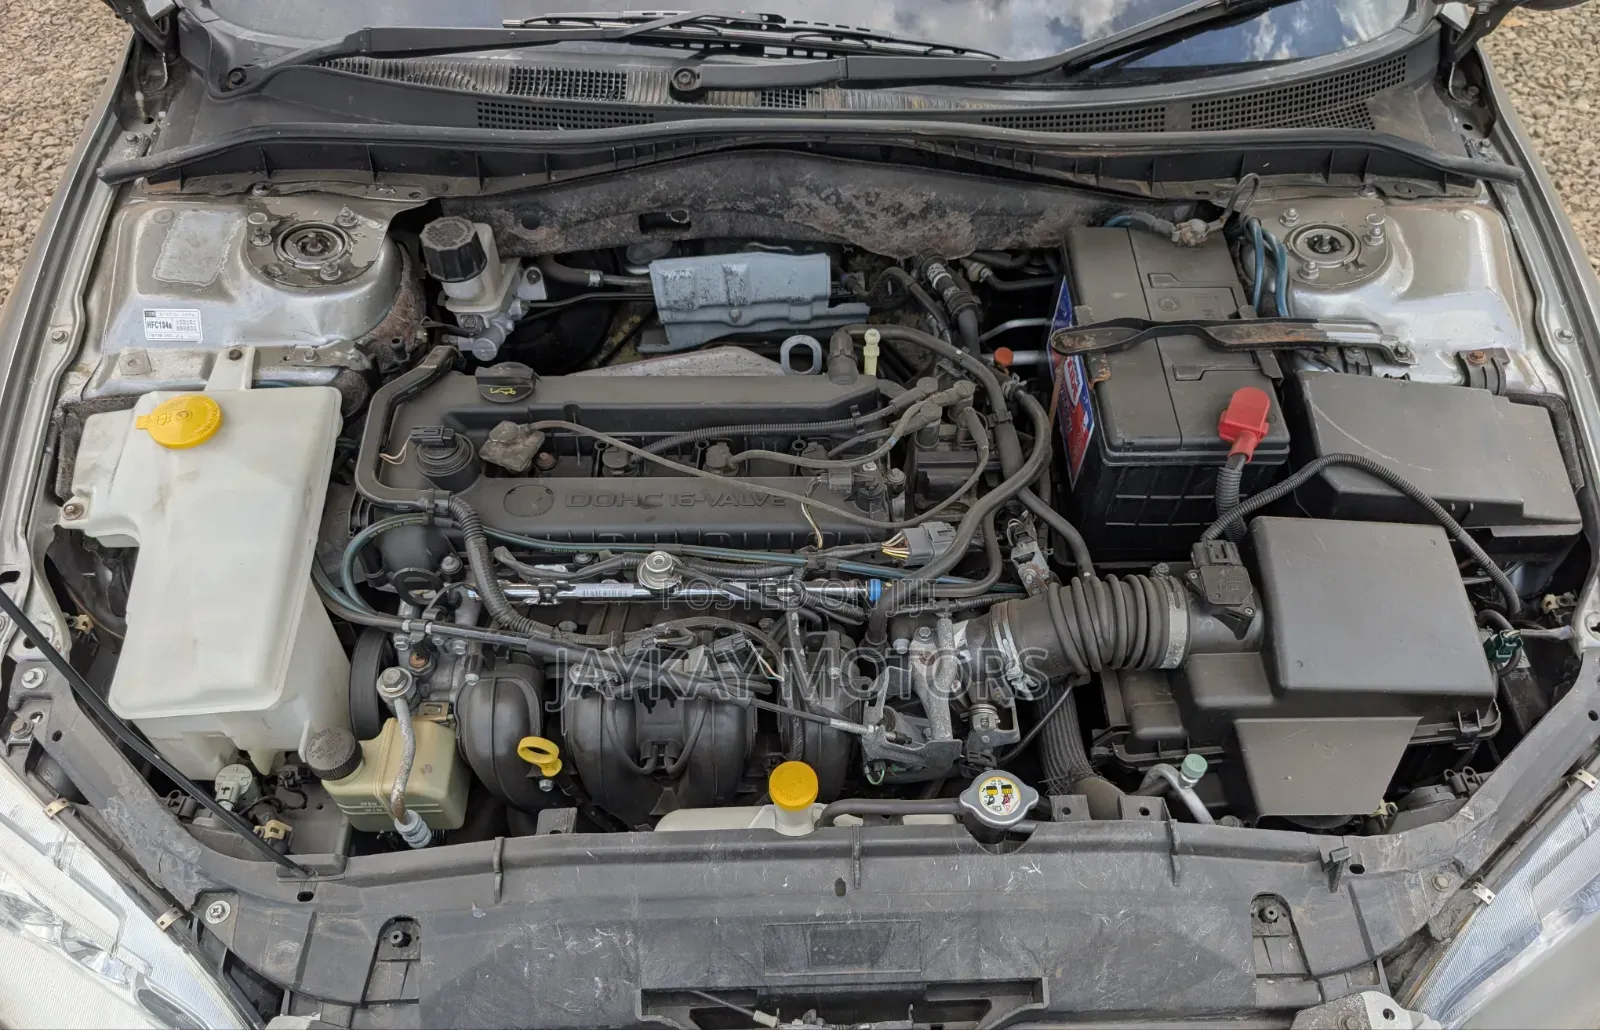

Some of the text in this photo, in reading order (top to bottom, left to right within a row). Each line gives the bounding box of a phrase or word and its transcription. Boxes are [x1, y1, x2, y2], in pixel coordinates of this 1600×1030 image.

[147, 320, 172, 330] HFC134a
[564, 491, 786, 508] DOHC 16-VALVE
